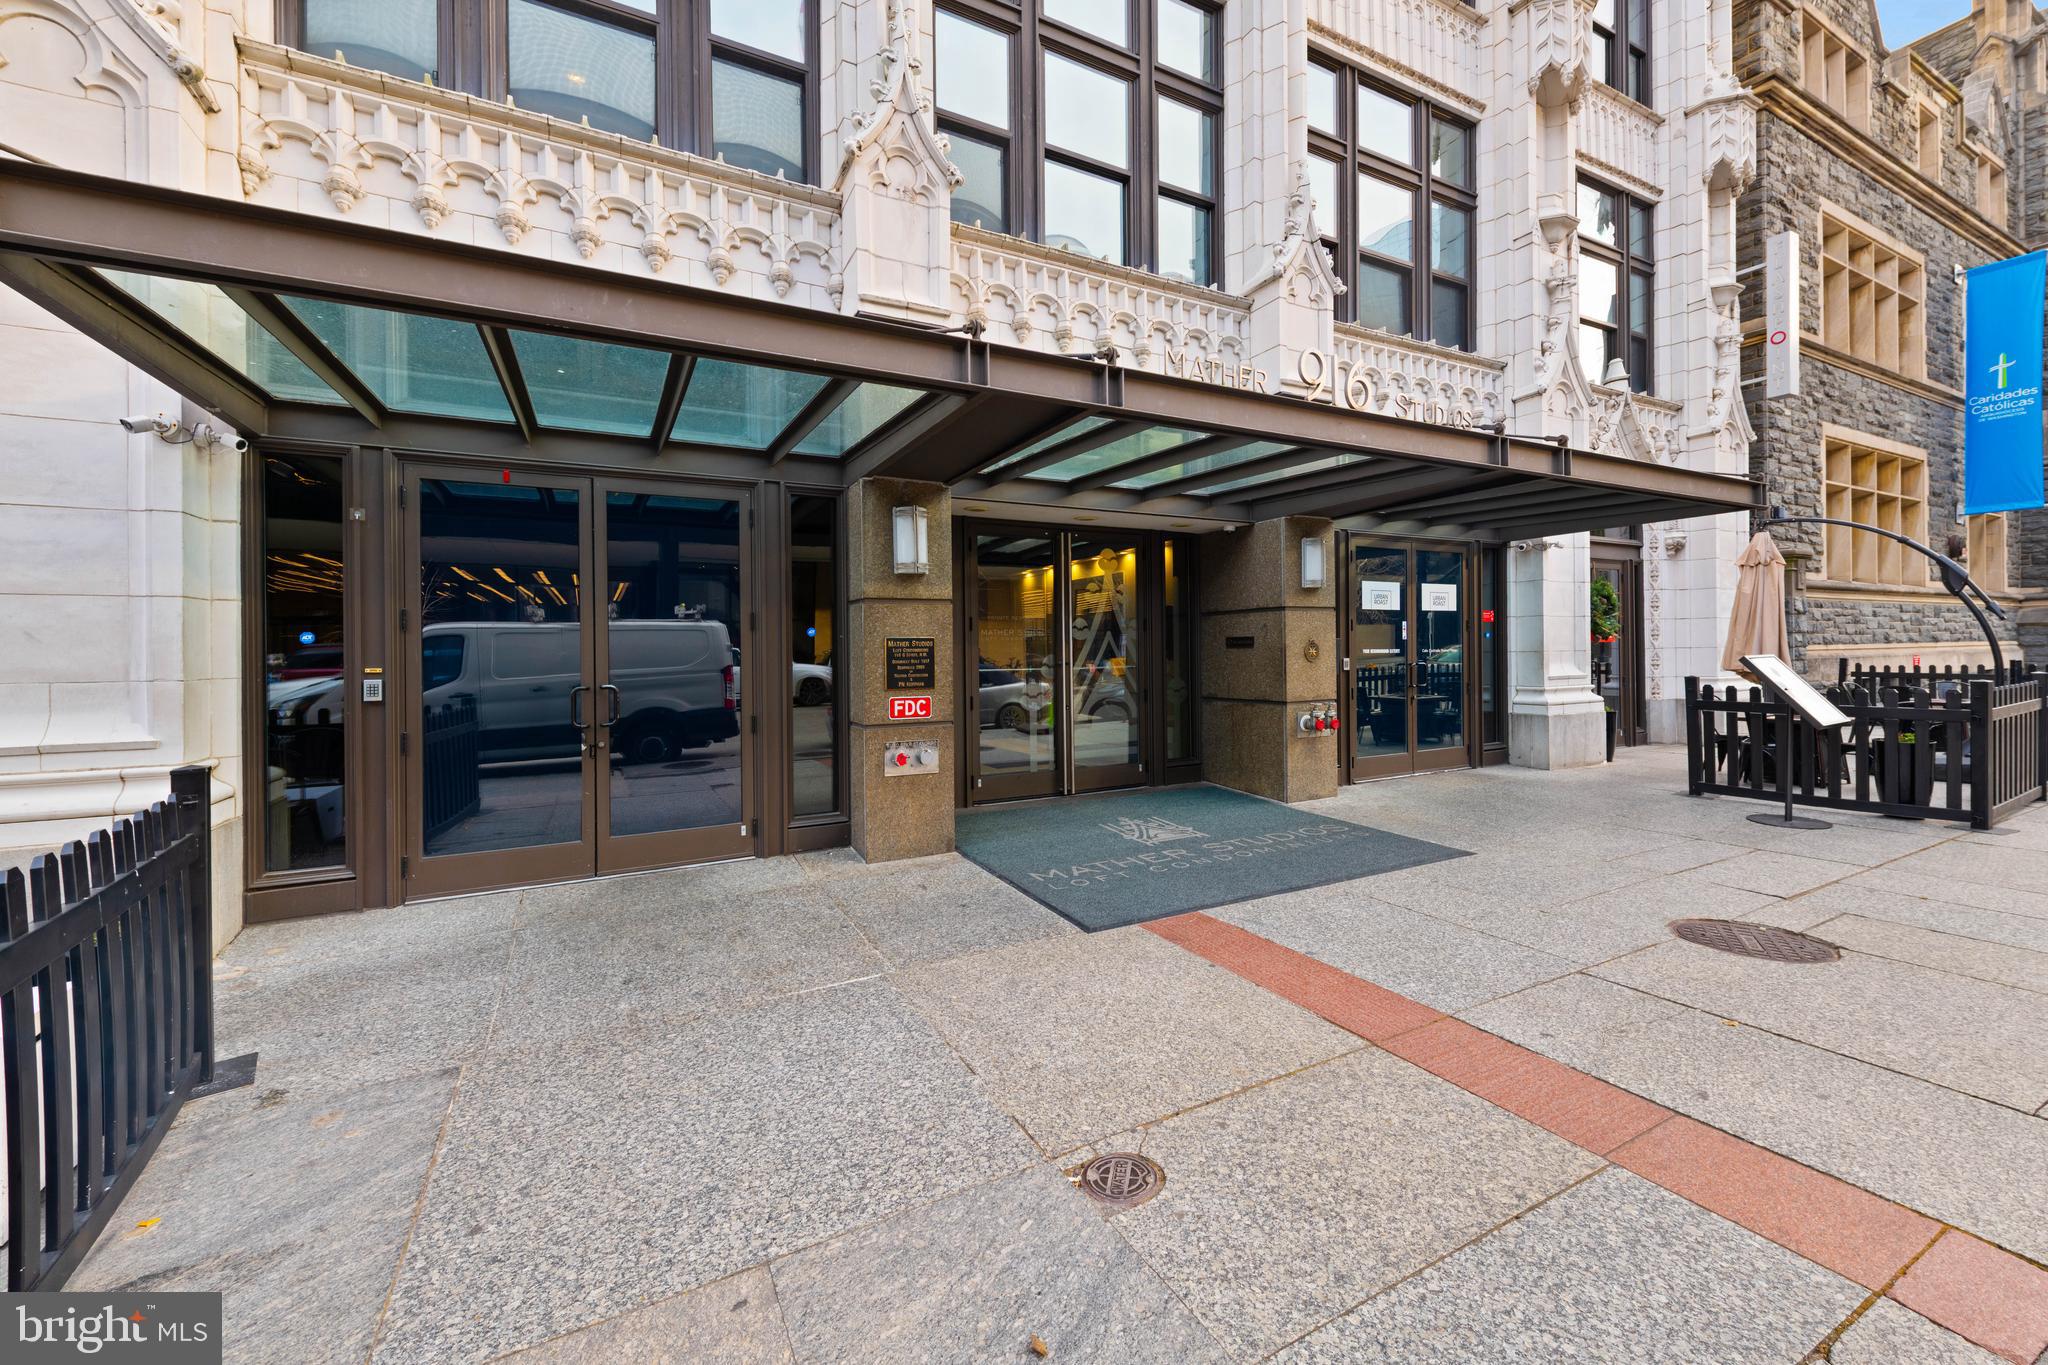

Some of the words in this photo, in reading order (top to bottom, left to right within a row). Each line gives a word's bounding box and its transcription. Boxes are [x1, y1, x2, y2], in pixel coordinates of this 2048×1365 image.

[1164, 348, 1269, 394] MATHER
[1298, 347, 1373, 411] 916
[1395, 392, 1473, 431] STUDIOS
[1969, 387, 2039, 406] Caridades
[1971, 397, 2035, 415] Católicas
[980, 629, 1014, 637] MATHER
[894, 699, 927, 717] FDC
[1028, 848, 1197, 881] MATHER
[1202, 824, 1349, 851] STUDIOS
[1048, 872, 1130, 890] LOFT
[1111, 1163, 1128, 1191] WATER
